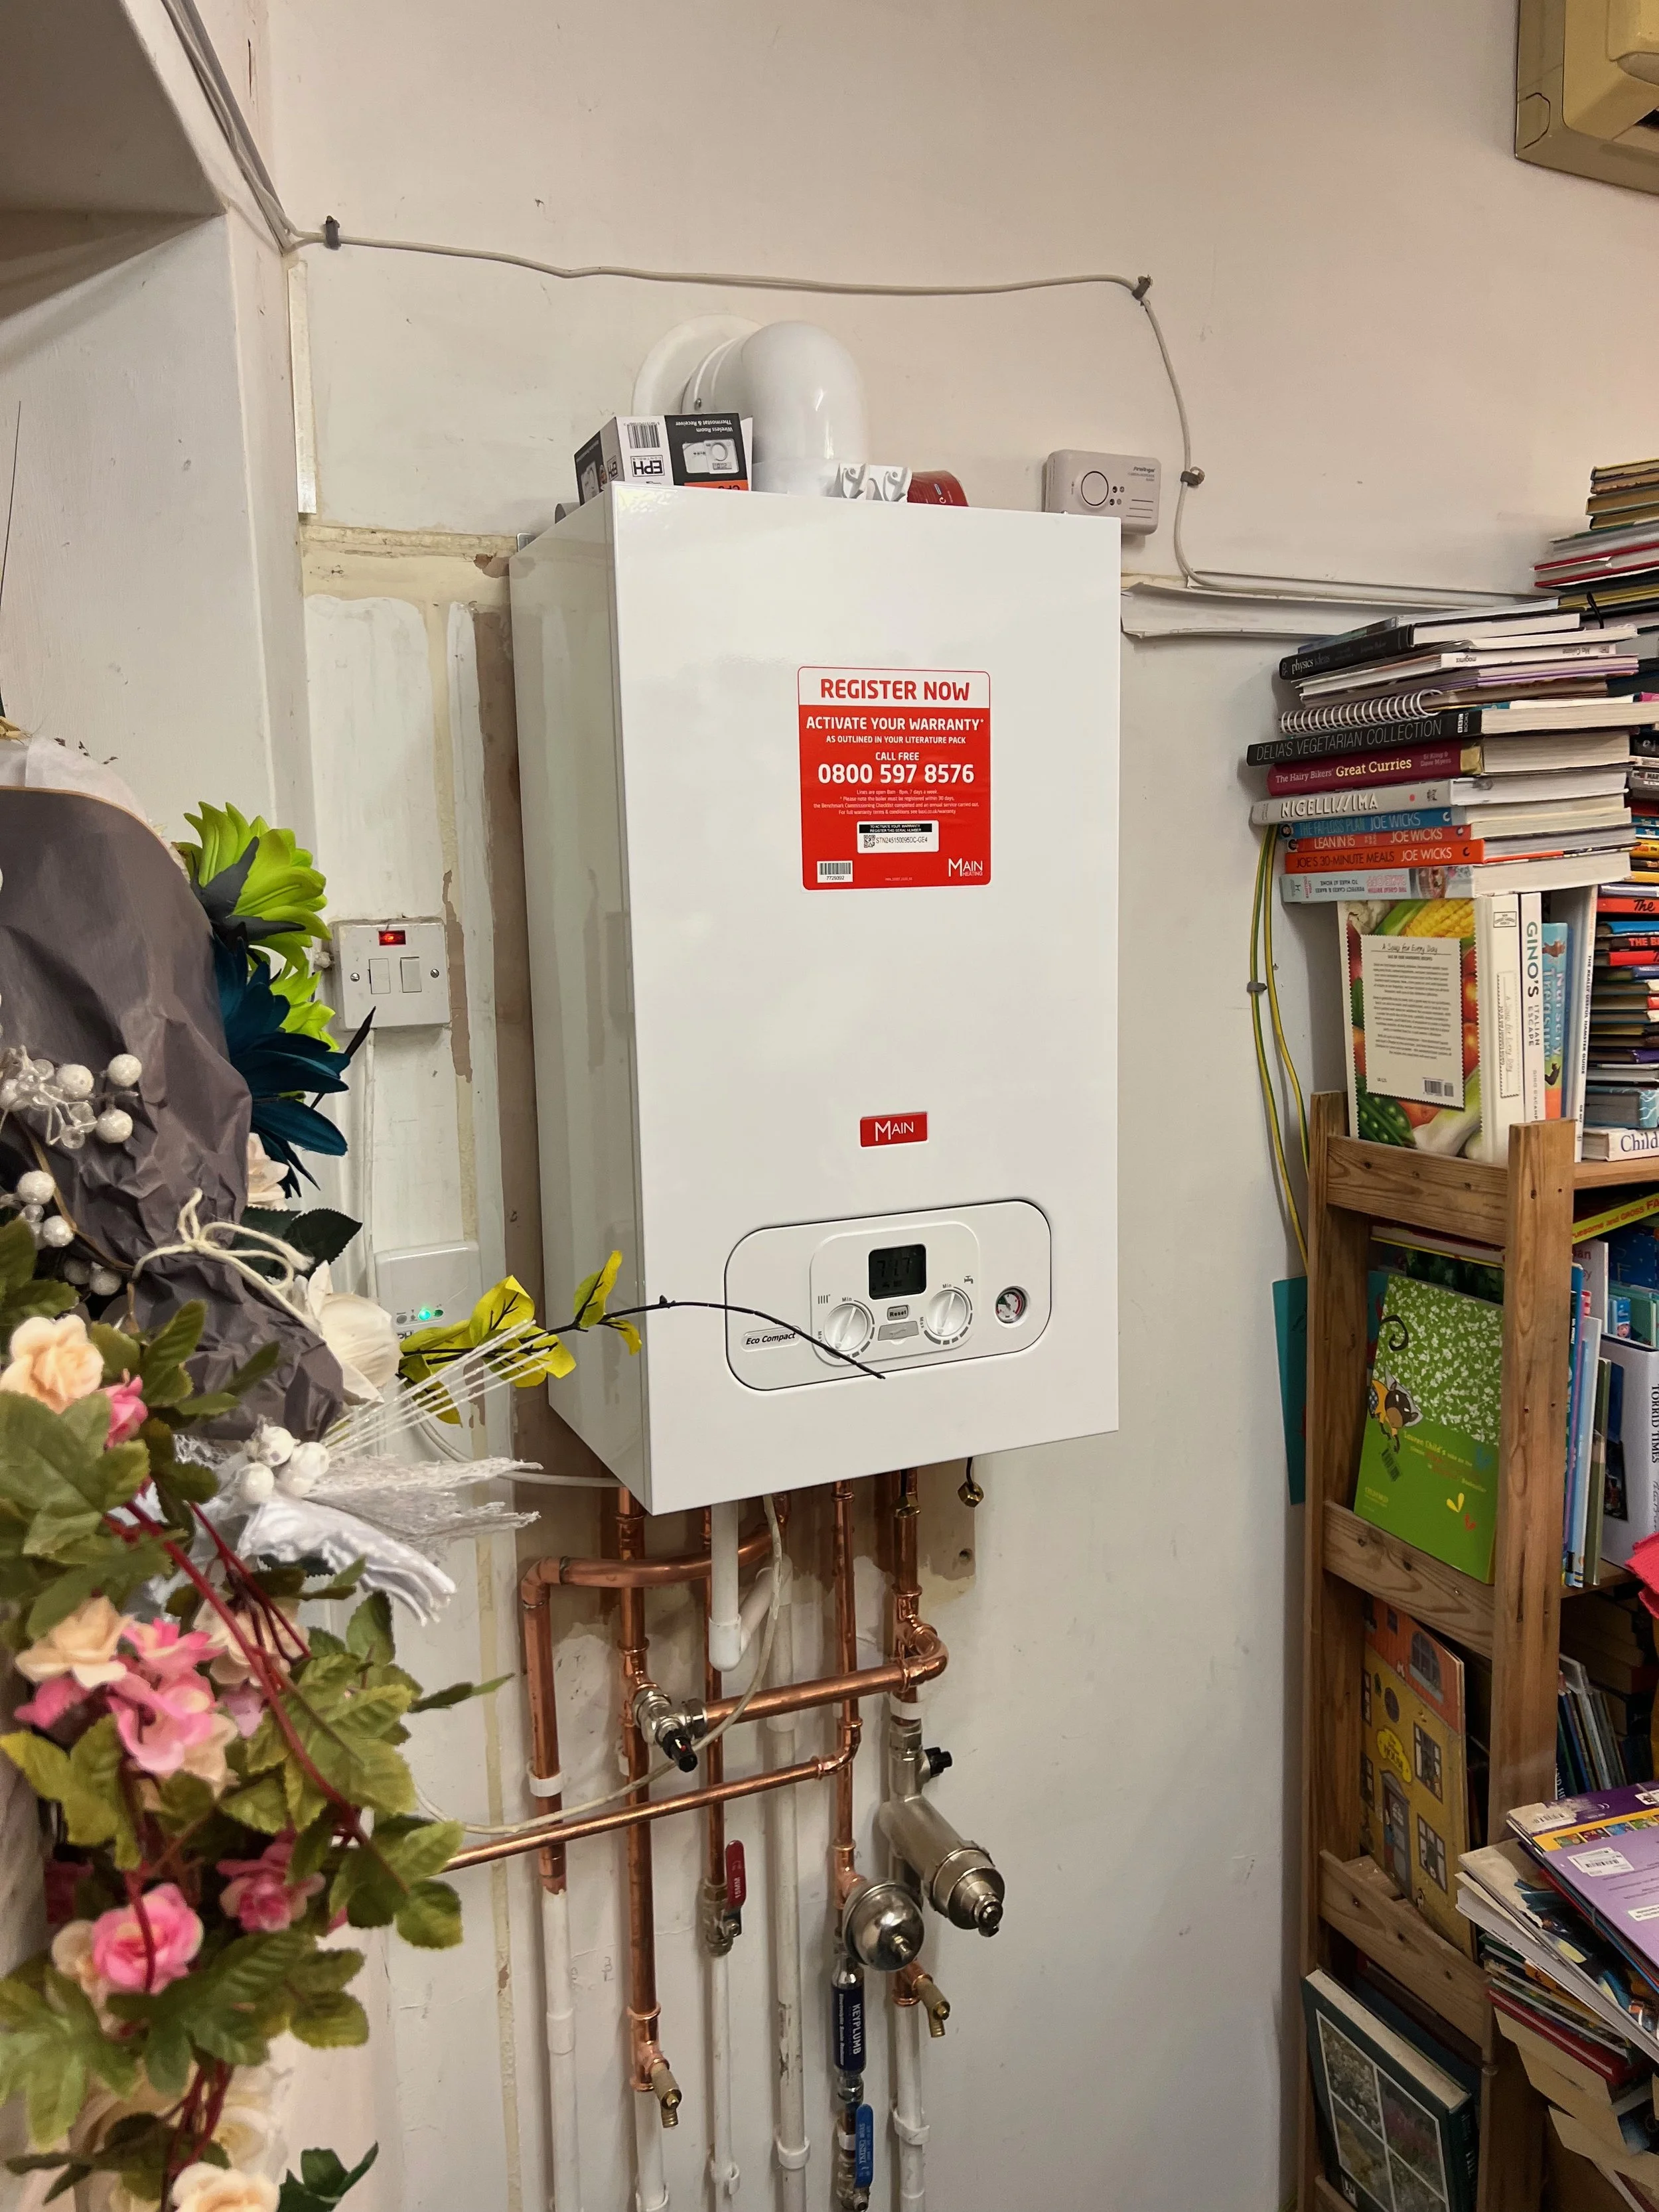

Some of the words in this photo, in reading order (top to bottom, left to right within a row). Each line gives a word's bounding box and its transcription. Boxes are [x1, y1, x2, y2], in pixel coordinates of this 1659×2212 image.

[632, 460, 663, 475] EPH
[1291, 658, 1314, 675] physics
[820, 678, 918, 700] REGISTER
[923, 681, 970, 701] NOW
[806, 716, 867, 730] ACTIVATE
[870, 717, 906, 731] YOUR
[826, 735, 836, 743] AS
[837, 735, 873, 743] OUTLINED
[874, 735, 883, 744] IN
[883, 735, 904, 744] YOUR
[905, 735, 947, 744] LITERATURE
[948, 736, 966, 745] PACK
[1256, 741, 1293, 761] DELIA'S
[1297, 731, 1363, 755] VEGETARIAN
[1366, 719, 1442, 745] COLLECTION
[875, 751, 897, 761] CALL
[898, 752, 920, 761] FREE
[818, 763, 873, 784] 0800
[879, 763, 918, 784] 597
[924, 763, 975, 784] 8576
[1275, 774, 1289, 784] The
[1289, 773, 1309, 782] Hairy
[1335, 763, 1366, 777] Great
[1368, 757, 1412, 773] Curries
[1281, 792, 1378, 818] NIGELLISSIMA
[1370, 815, 1388, 830] JOE
[1388, 812, 1421, 828] WICKS
[1314, 837, 1336, 849] LEAN
[1336, 836, 1346, 848] IN
[1348, 834, 1356, 847] 15
[1390, 830, 1409, 844] JOE
[1409, 828, 1443, 842] WICKS
[948, 857, 983, 877] MAIN
[1296, 855, 1318, 869] JOE'S
[1319, 853, 1364, 867] 30-MINUTE
[1366, 851, 1394, 863] MEALS
[1401, 849, 1418, 862] JOE
[1420, 847, 1452, 860] WICKS
[1633, 899, 1656, 912] The
[1628, 938, 1648, 946] THE
[1526, 921, 1540, 998] GINO'S
[1553, 971, 1565, 1057] Nursery
[875, 1120, 914, 1142] MAIN
[762, 1332, 796, 1343] Compact
[851, 2003, 861, 2055] KEYPLUMB
